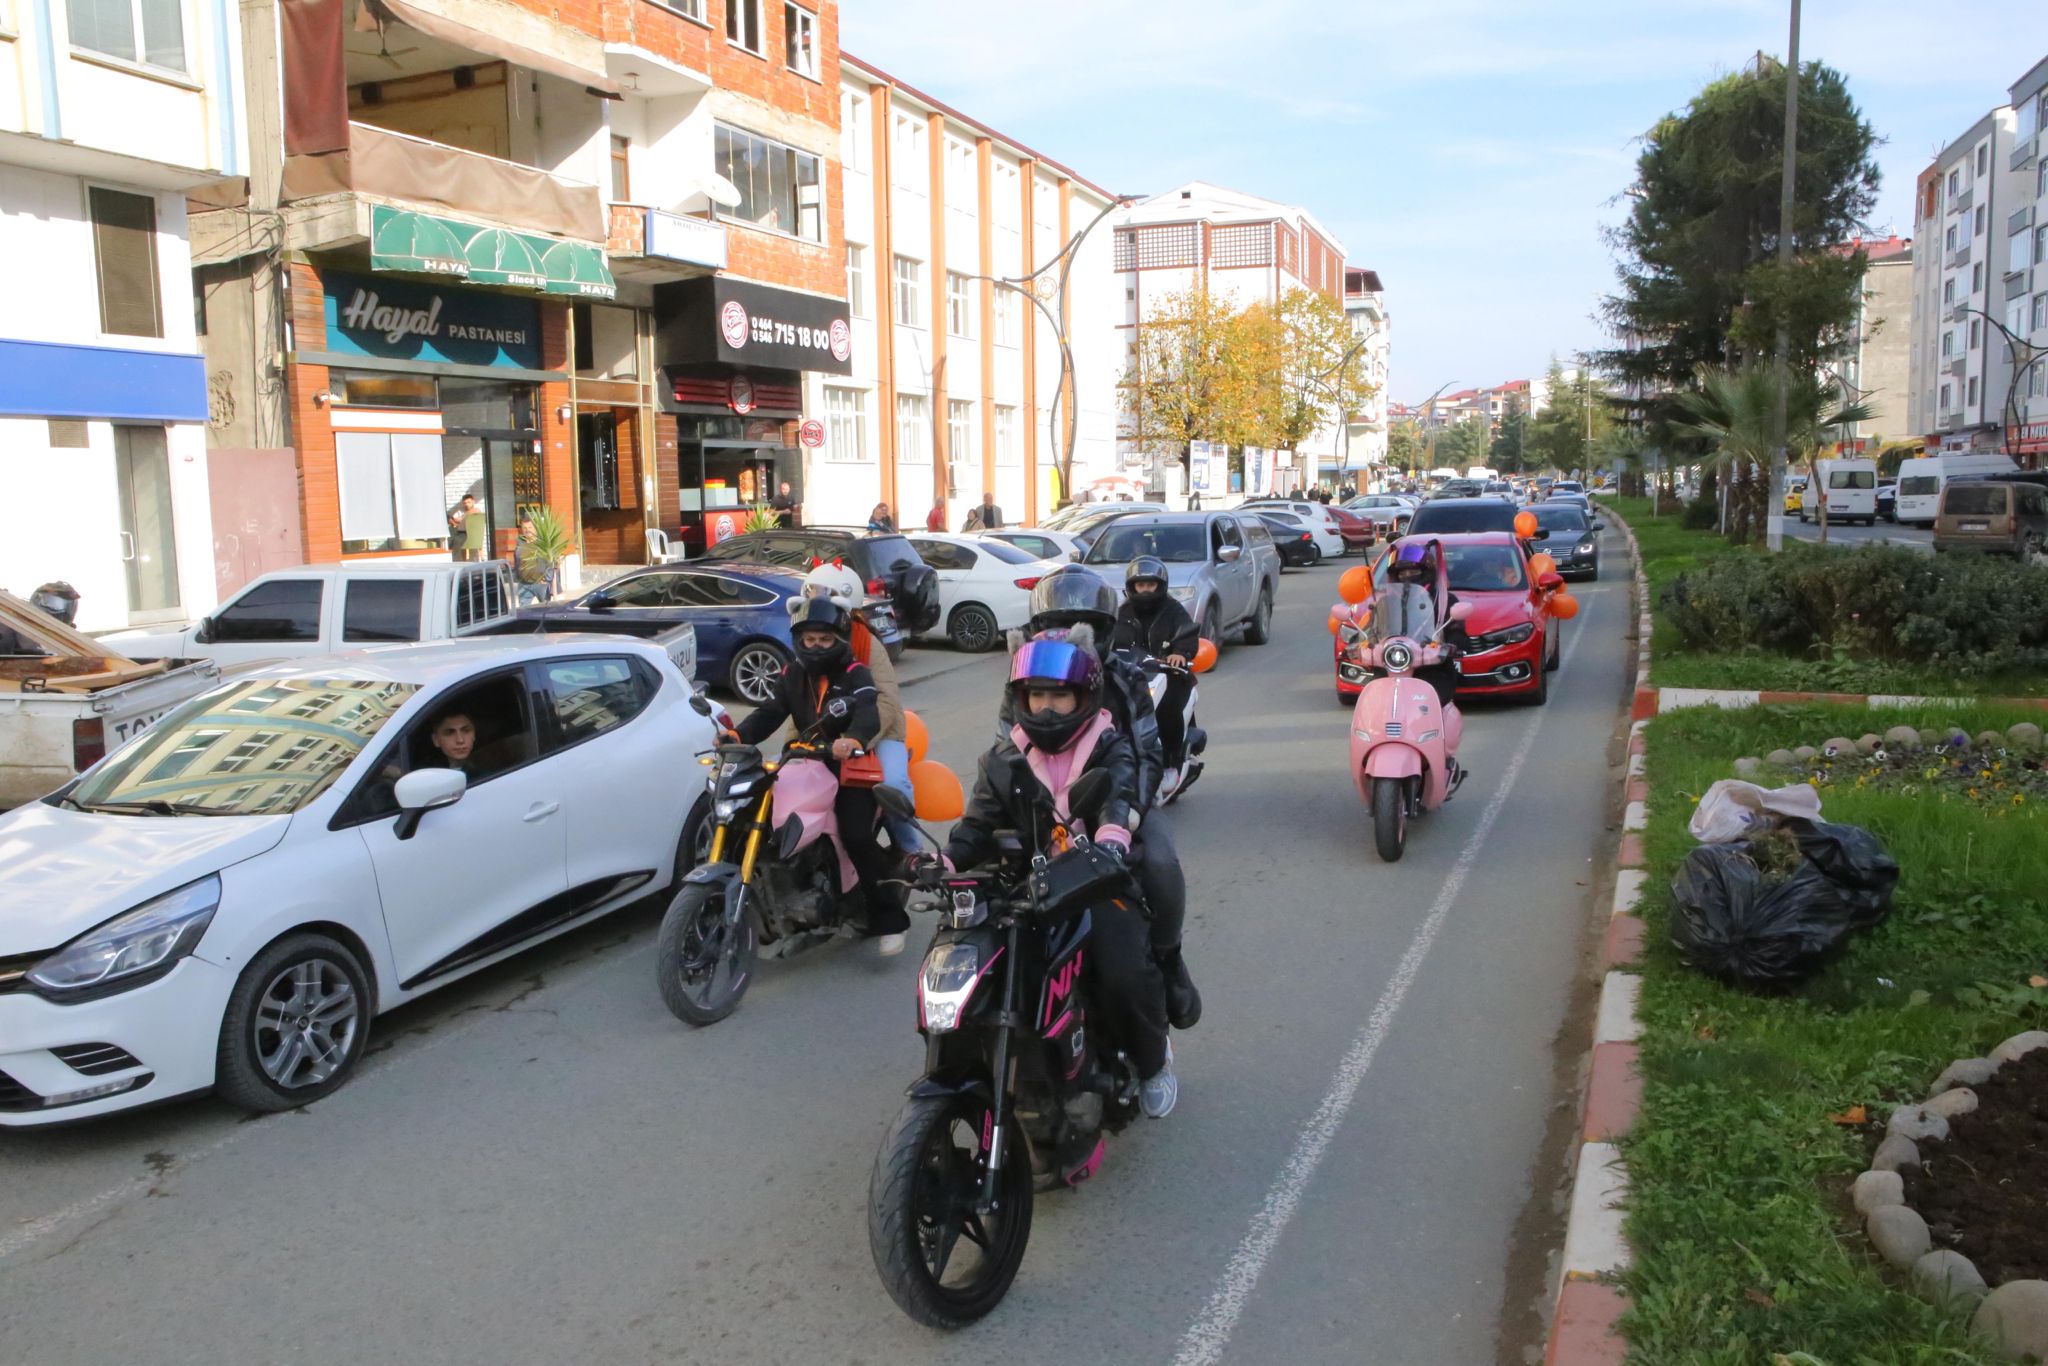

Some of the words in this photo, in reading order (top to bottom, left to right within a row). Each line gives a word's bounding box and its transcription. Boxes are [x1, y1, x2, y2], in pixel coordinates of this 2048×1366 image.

[423, 259, 469, 275] HAYAL
[507, 274, 535, 285] Since
[580, 284, 616, 298] HAYA
[343, 288, 443, 345] Hayal
[449, 324, 526, 345] PASTANESİ
[775, 323, 795, 345] 715
[797, 327, 811, 347] 18
[814, 330, 829, 350] 00
